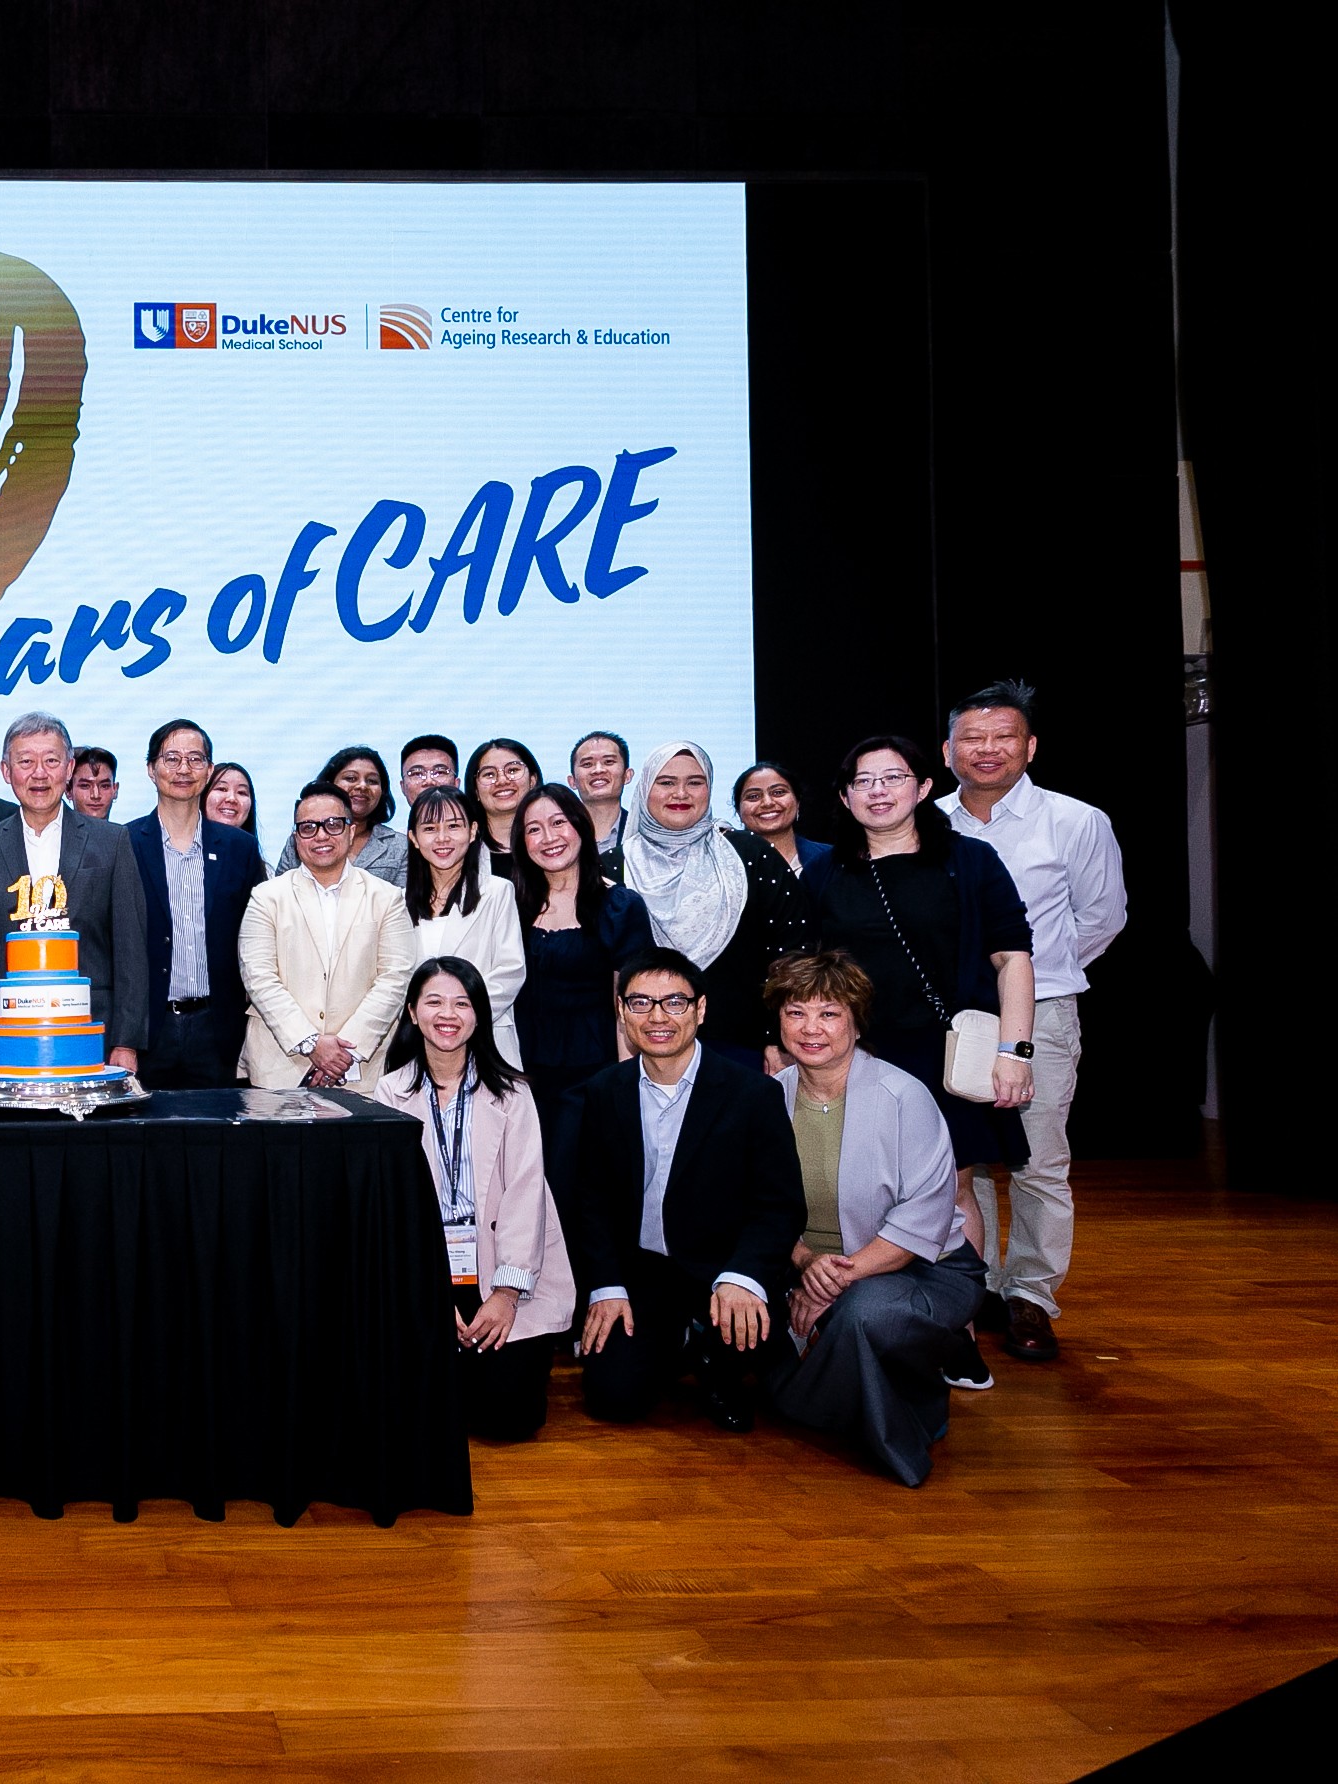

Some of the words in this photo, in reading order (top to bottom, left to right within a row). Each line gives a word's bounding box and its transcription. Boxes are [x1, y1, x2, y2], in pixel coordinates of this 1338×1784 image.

[221, 313, 347, 335] DukeNUS
[440, 307, 492, 323] Centre
[496, 306, 519, 323] for
[221, 338, 275, 350] Medical
[278, 338, 323, 350] School
[440, 329, 496, 350] Ageing
[501, 328, 571, 345] Research
[576, 329, 589, 345] &
[594, 328, 671, 345] Education
[206, 520, 338, 665] of
[334, 446, 678, 643] CARE
[7, 874, 68, 921] 10
[35, 917, 71, 931] CARE
